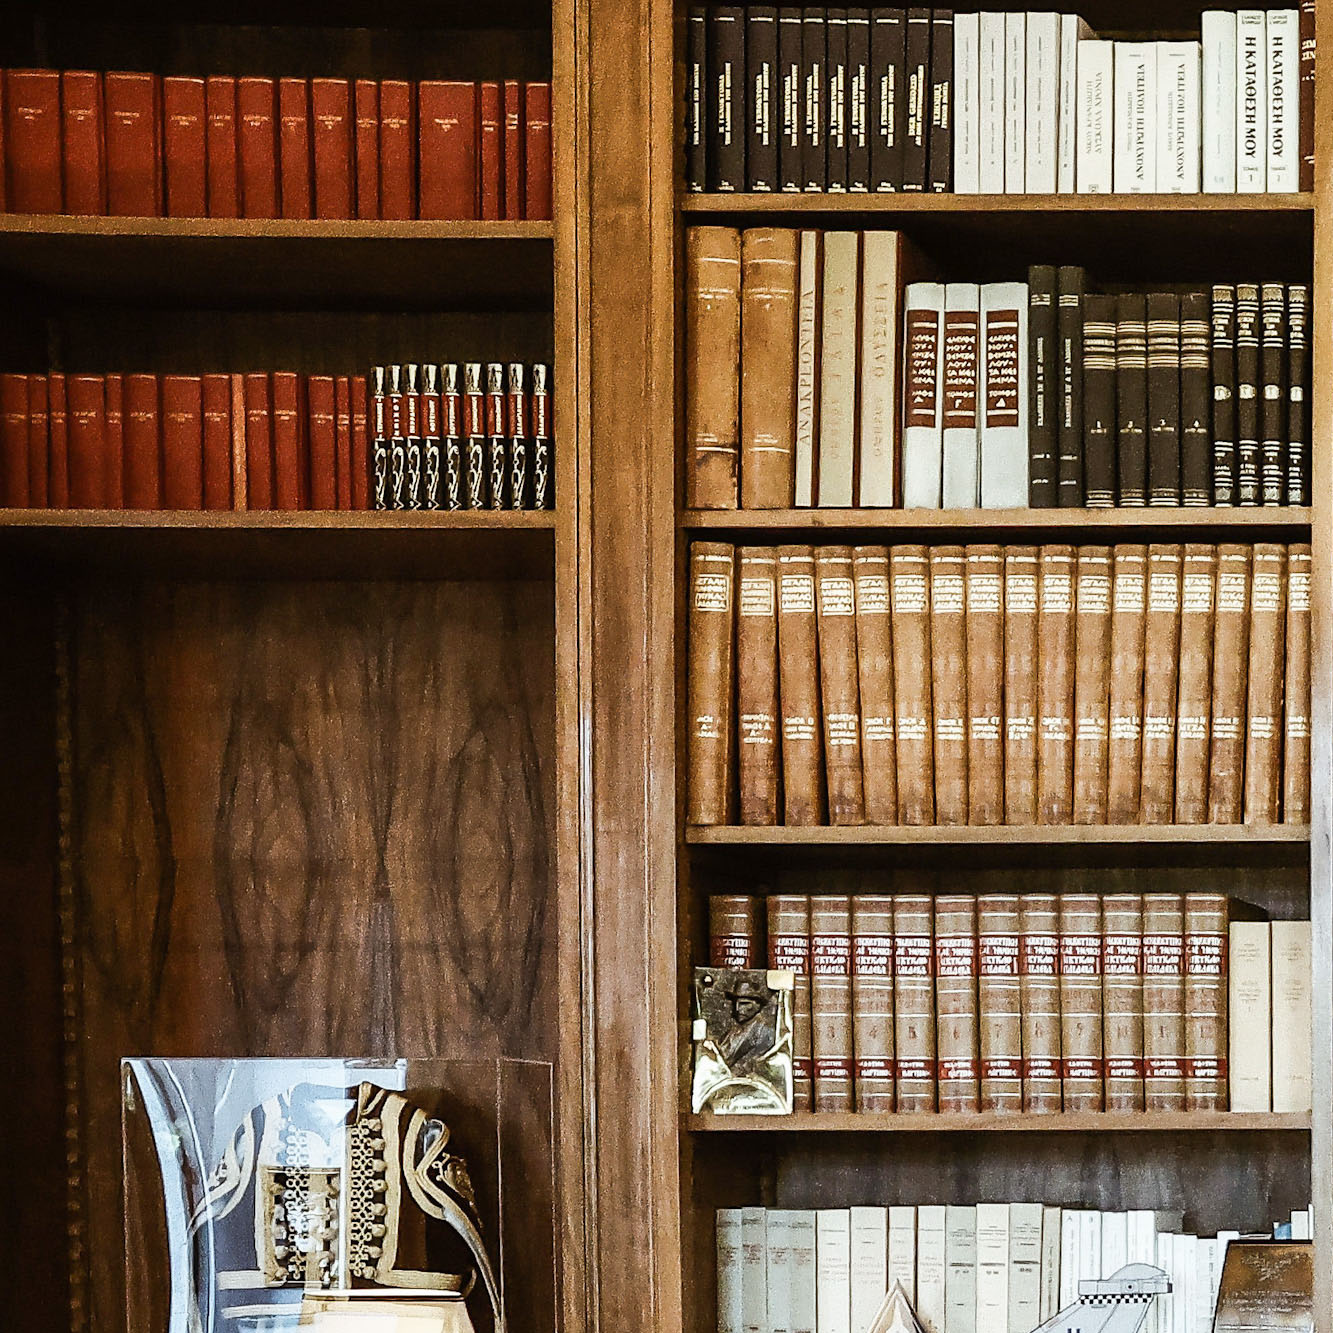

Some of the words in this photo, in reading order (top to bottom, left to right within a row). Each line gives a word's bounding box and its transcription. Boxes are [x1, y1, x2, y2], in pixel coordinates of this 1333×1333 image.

[1245, 37, 1257, 47] Η
[1272, 36, 1284, 47] Η
[1245, 50, 1257, 124] ΚΑΤΑΘΕΣΗ
[1272, 50, 1284, 124] ΚΑΤΑΘΕΣΗ
[1136, 118, 1145, 180] ΑΝΟΧΥΡΩΤΗ
[1176, 117, 1185, 180] ΑΝΟΧΥΡΩΤΗ
[1245, 127, 1257, 159] ΜΟΥ
[1272, 127, 1284, 158] ΜΟΥ
